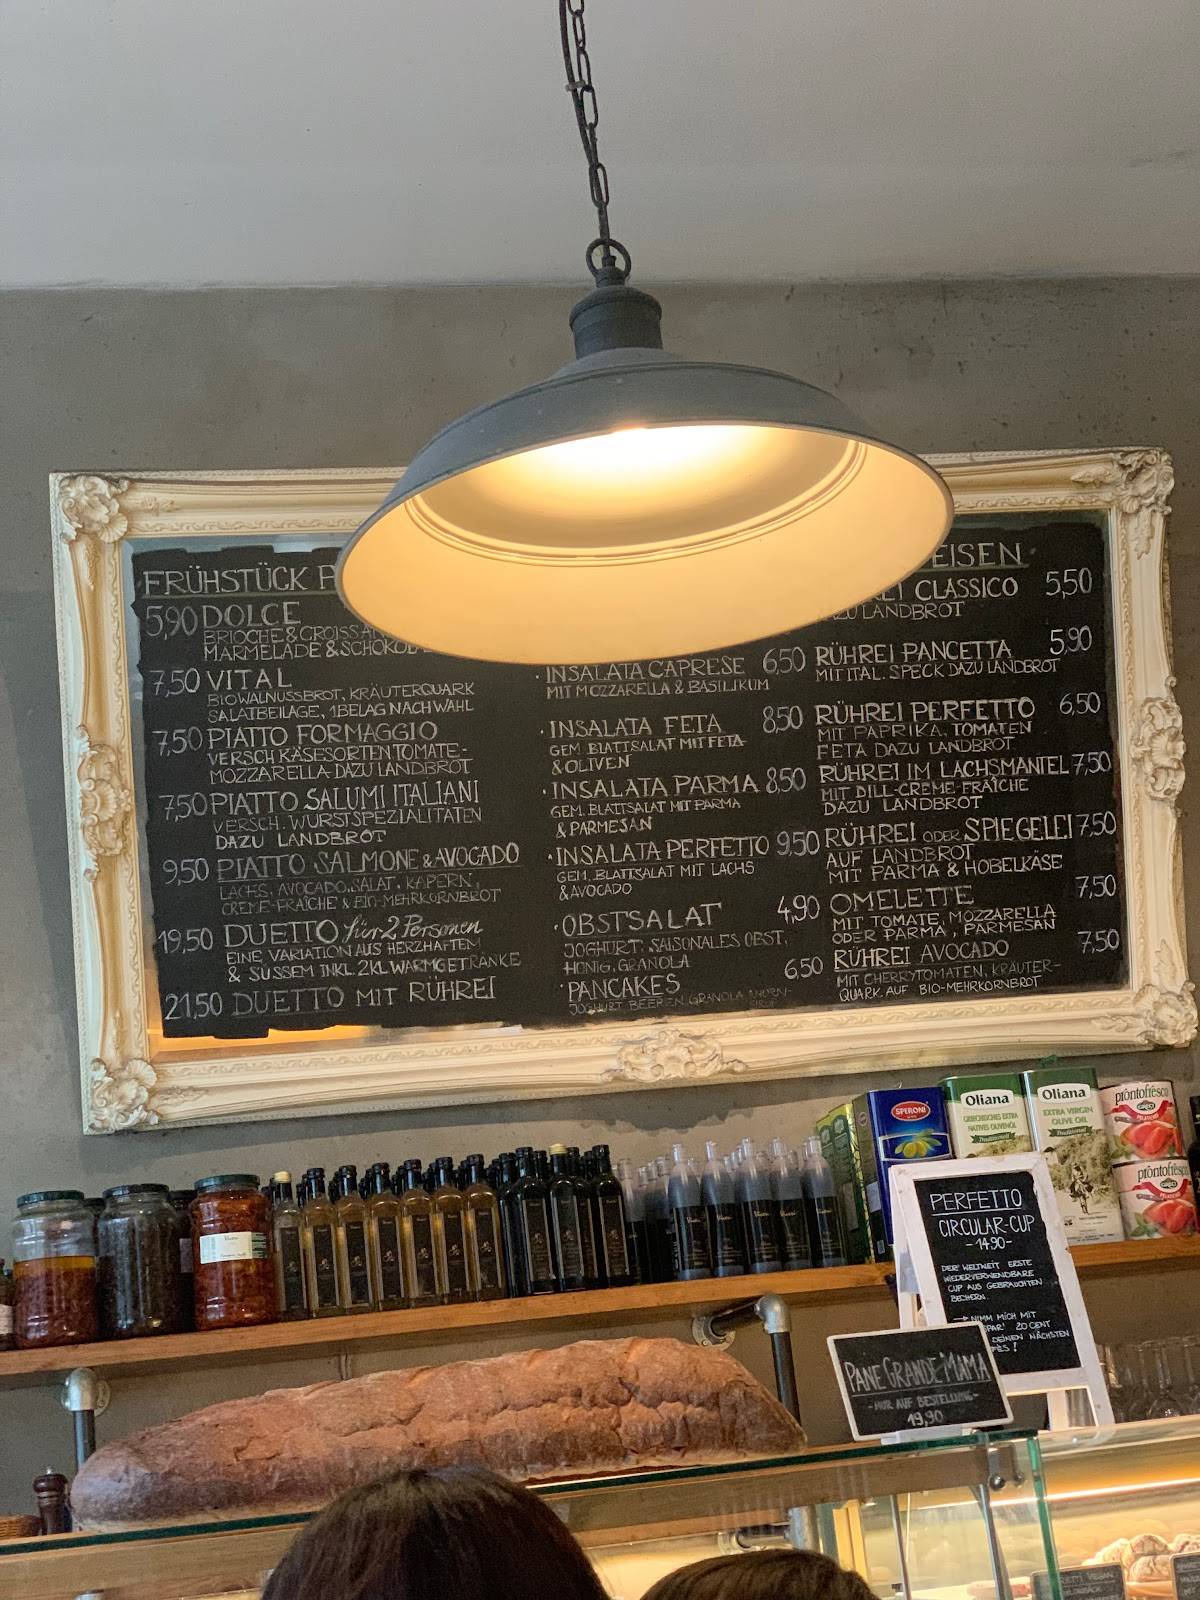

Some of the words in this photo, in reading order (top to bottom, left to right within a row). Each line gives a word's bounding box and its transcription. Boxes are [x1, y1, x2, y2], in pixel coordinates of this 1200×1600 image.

[932, 543, 1022, 567] EISEN
[143, 562, 308, 596] FRÜHSTÜCK
[915, 577, 1018, 601] CLASSICO
[1045, 568, 1092, 598] 5,50
[146, 605, 198, 640] 5,90
[202, 601, 301, 629] DOLCE
[863, 601, 965, 620] LANDBROT
[815, 641, 893, 666] RÜHREI
[901, 640, 1011, 663] PANCETTA
[1050, 625, 1092, 655] 5,90
[546, 663, 645, 683] INSALATA
[649, 657, 745, 677] CAPRESE
[762, 647, 806, 675] 6,50
[816, 668, 844, 682] MIT
[890, 663, 944, 680] SPECK
[950, 661, 983, 676] DAZU
[988, 658, 1060, 674] LANDBROT
[150, 668, 200, 697] 7,50
[207, 668, 292, 691] VITAL
[547, 686, 572, 699] MIT
[576, 682, 670, 697] MOZZARELLA
[687, 679, 769, 693] BASILIKUM
[815, 701, 903, 725] RÜHREI
[910, 696, 1035, 721] PERFETTO
[1060, 692, 1100, 716] 6,50
[550, 717, 652, 738] INSALATA
[664, 714, 722, 734] FETA
[762, 706, 803, 734] 8,50
[818, 726, 849, 742] MIT
[952, 721, 1032, 736] TOMATEN
[152, 727, 203, 757] 7,50
[207, 725, 287, 749] PIATTO
[298, 721, 438, 745] FORMAGGIO
[588, 737, 676, 754] BLATTSALAT
[680, 735, 705, 750] MIT
[817, 743, 866, 759] FETA
[875, 741, 919, 755] DAZU
[929, 737, 1015, 754] LANDBROT
[334, 761, 374, 778] DAZU
[378, 757, 474, 777] LANDBROT
[820, 761, 899, 783] RÜHREI
[908, 762, 930, 779] IM
[940, 756, 1069, 779] LACHSMANTEL
[1073, 751, 1111, 776] 7,50
[552, 777, 667, 799] INSALATA
[672, 774, 761, 796] PARMA
[766, 766, 806, 794] 8,50
[822, 787, 850, 802] MIT
[158, 792, 207, 821] 7,50
[210, 790, 298, 814] PIATTO
[303, 786, 385, 811] SALUMI
[393, 780, 480, 807] ITALIANI
[588, 800, 666, 815] BLATTSALAT
[694, 798, 740, 811] PARMA
[824, 801, 870, 816] DAZU
[883, 796, 983, 812] LANDBROT
[569, 816, 652, 836] PARMESAN
[824, 821, 916, 849] RÜHREI
[923, 830, 961, 842] ODER
[964, 814, 1073, 842] SPIEGELEI
[1076, 811, 1117, 838] 7,50
[216, 833, 264, 850] DAZU
[278, 829, 387, 849] LANDBROT
[556, 841, 661, 866] INSALATA
[665, 835, 769, 859] PERFETTO
[777, 830, 820, 856] 9,50
[163, 857, 209, 886] 9,50
[217, 853, 305, 881] PIATTO
[314, 849, 418, 874] SALMONE
[826, 850, 863, 869] AUF
[872, 843, 975, 865] LANDBROT
[828, 868, 859, 885] MIT
[871, 863, 939, 882] PARMA
[947, 862, 960, 877] &
[965, 850, 1063, 876] HOBELKÄSE
[595, 865, 674, 880] BLATTSALAT
[681, 863, 705, 877] MIT
[711, 861, 754, 876] LACHS
[829, 885, 975, 915] OMELETTE
[1075, 874, 1117, 900] 7,50
[562, 902, 722, 937] OBSTSALAT
[777, 894, 819, 924] 4,90
[833, 916, 863, 931] MIT
[949, 904, 1057, 923] MOZZARELLA
[158, 927, 213, 953] 19,50
[224, 920, 339, 947] DUETTO
[342, 914, 383, 943] für
[381, 915, 401, 940] 2
[401, 914, 483, 938] Personen
[831, 929, 877, 944] ODER
[965, 919, 1056, 936] PARMESAN
[268, 945, 351, 961] VARIATION
[356, 943, 382, 956] AUS
[834, 945, 910, 970] RÜHREI
[921, 939, 1009, 963] AVOCADO
[1078, 929, 1120, 954] 7,50
[618, 954, 689, 972] GRANOLA
[568, 973, 680, 1001] PANCAKES
[785, 956, 823, 980] 6,50
[837, 973, 859, 987] MIT
[165, 992, 223, 1020] 21,50
[231, 987, 344, 1016] DUETTO
[356, 988, 397, 1007] MIT
[409, 975, 497, 1001] RÜHREI
[965, 1094, 1009, 1106] Oliana
[1042, 1088, 1086, 1100] Oliana
[1043, 1108, 1065, 1117] EXTRA
[1067, 1106, 1094, 1114] VIRGIN
[930, 1189, 1022, 1211] PERFETTO
[939, 1215, 1034, 1237] CIRCULAR-CUP
[1008, 1259, 1032, 1267] ERSTE
[948, 1284, 962, 1293] CUP
[1029, 1320, 1050, 1328] CENT
[844, 1361, 887, 1392] PANE
[883, 1357, 943, 1388] GRANDE
[908, 1410, 944, 1427] 19,90
